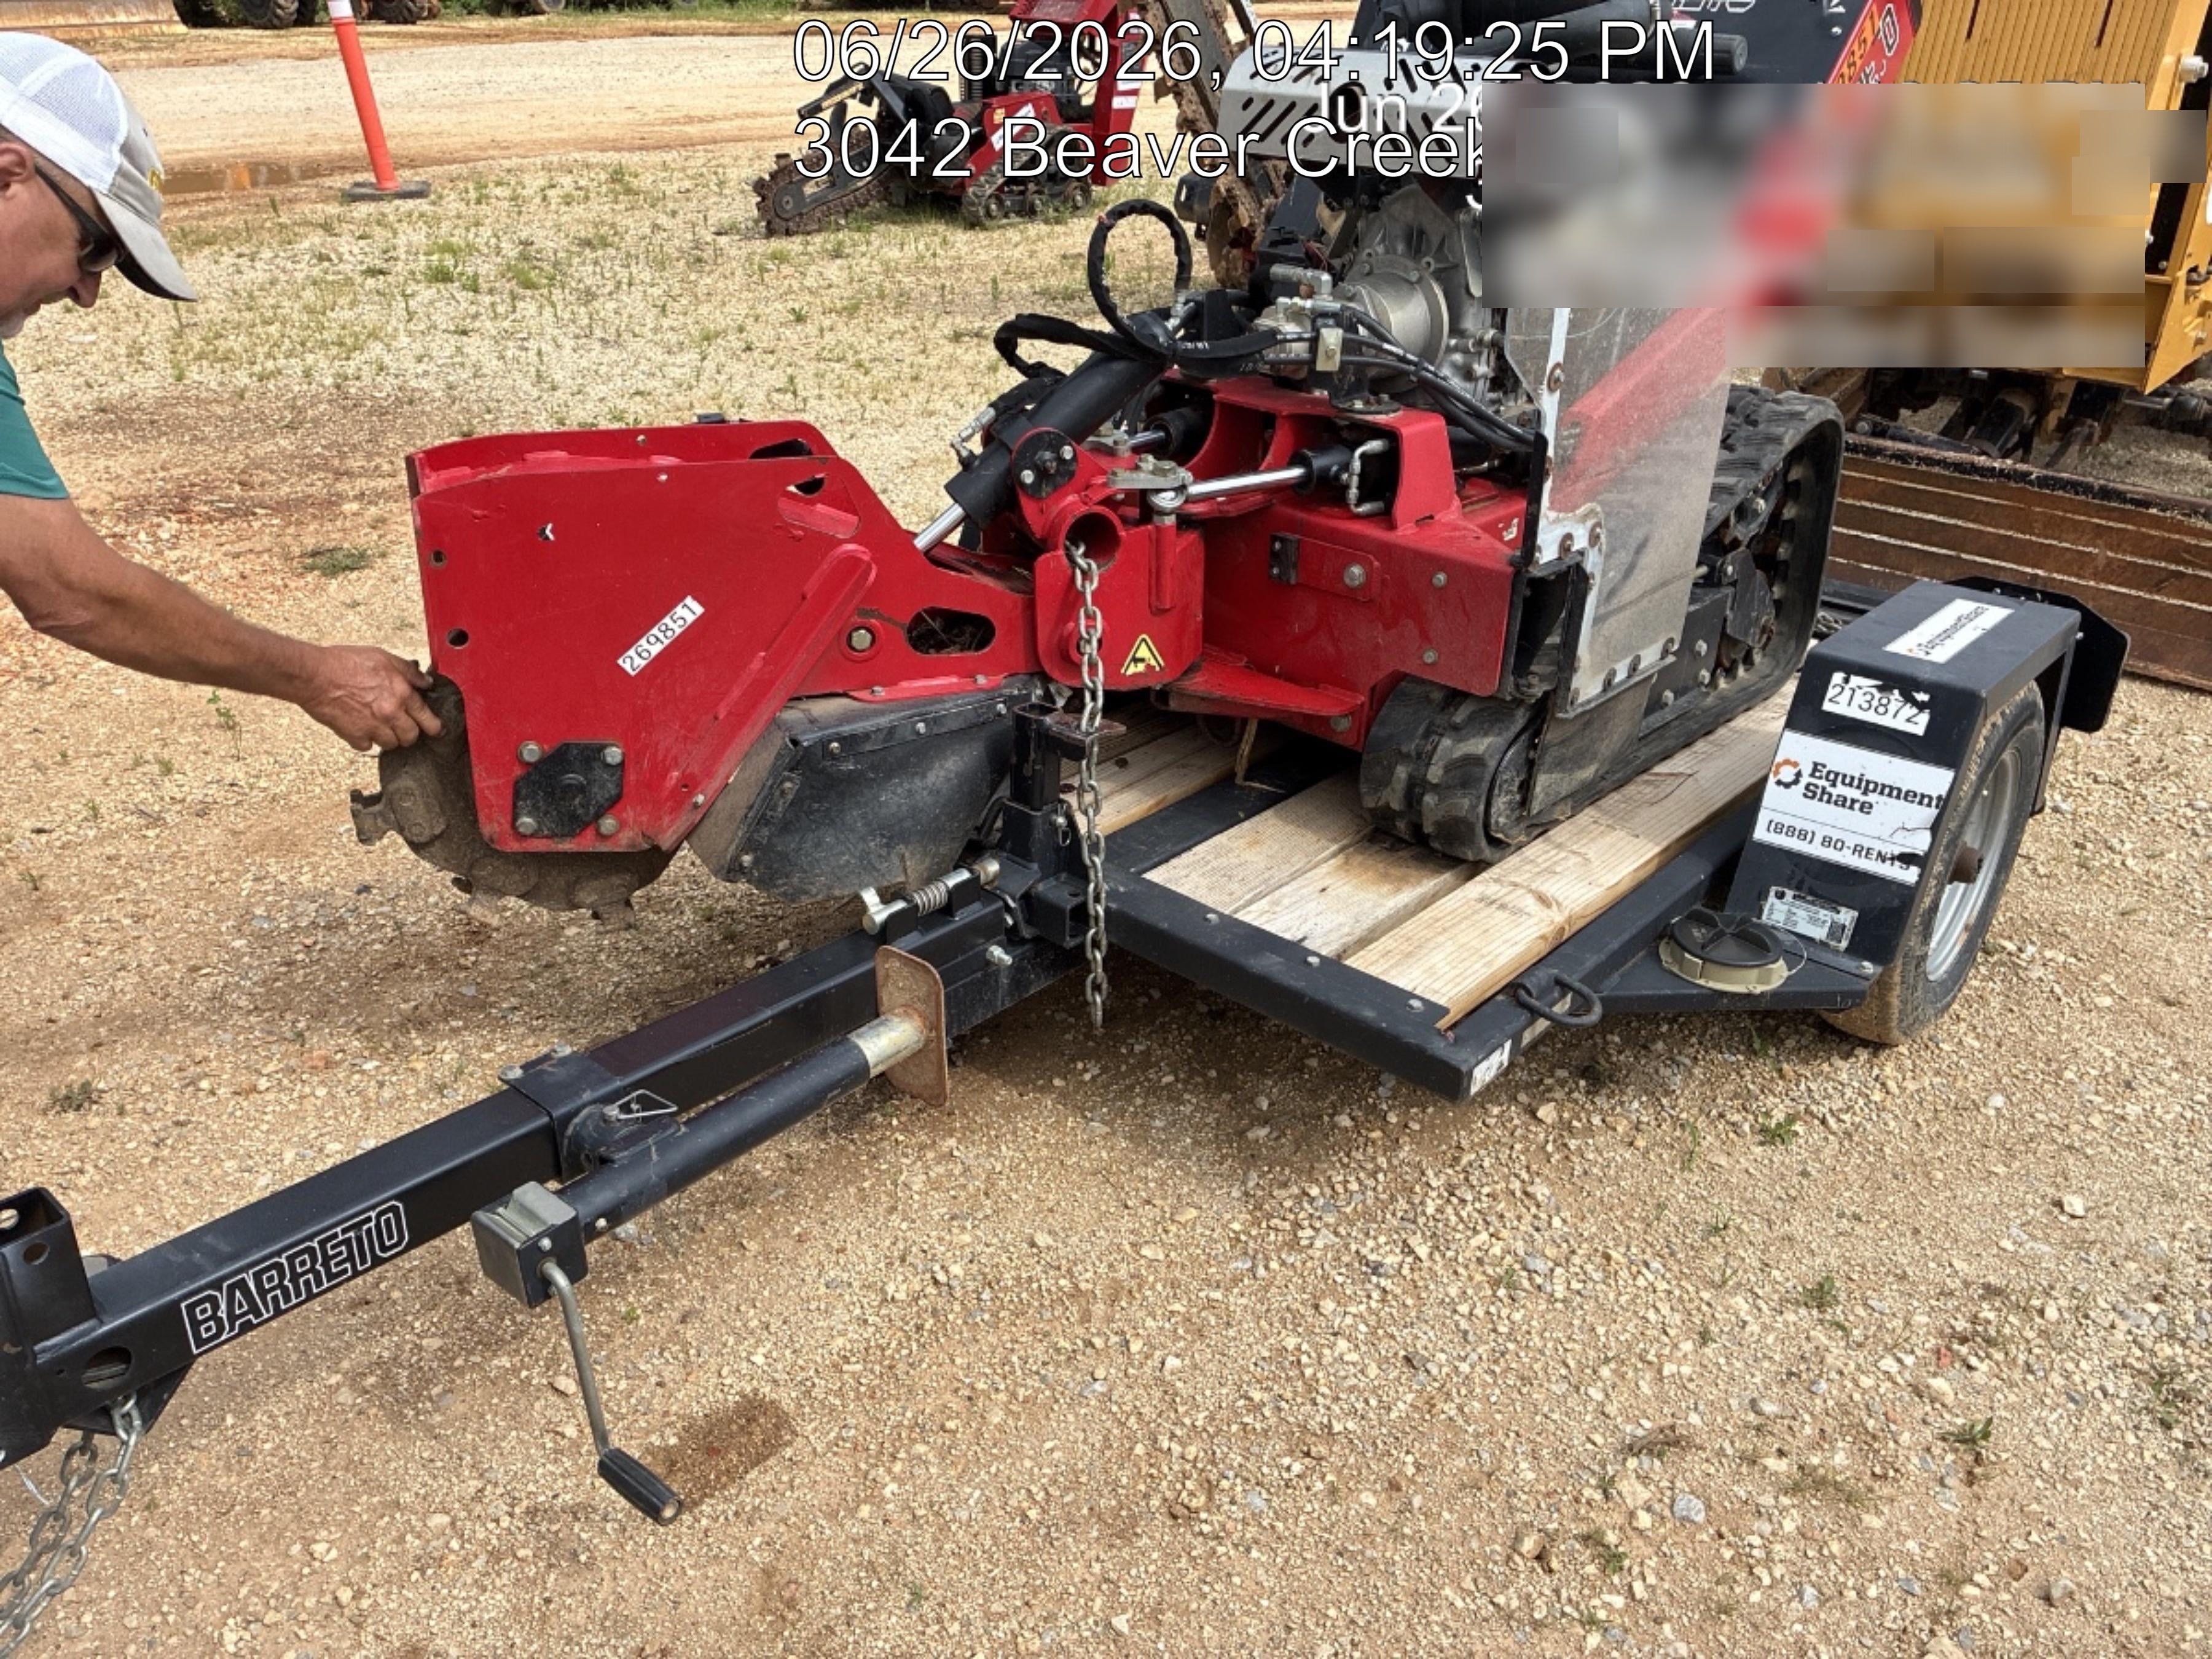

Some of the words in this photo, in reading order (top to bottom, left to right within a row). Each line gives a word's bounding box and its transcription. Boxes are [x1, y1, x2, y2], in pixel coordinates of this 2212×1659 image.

[622, 602, 697, 672] 269851
[1827, 683, 1921, 726] 213872
[1802, 782, 1874, 815] Share
[1808, 761, 1946, 810] Equipment
[1766, 818, 1817, 845] (888)
[181, 1199, 409, 1354] BARRETO
